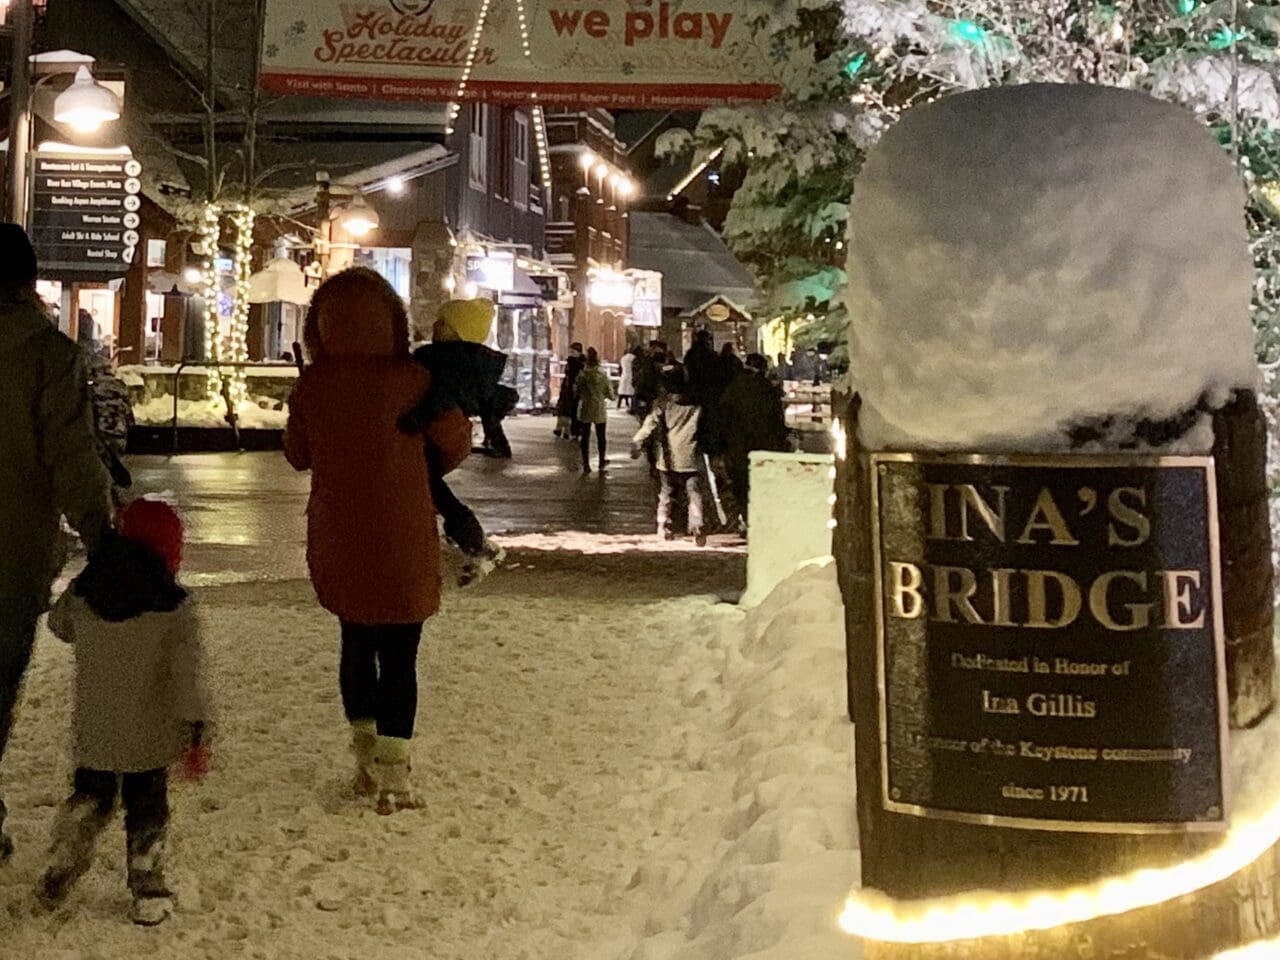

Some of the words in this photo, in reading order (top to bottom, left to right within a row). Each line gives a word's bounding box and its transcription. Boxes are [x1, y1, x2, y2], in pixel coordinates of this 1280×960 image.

[347, 11, 467, 45] Holiday
[549, 10, 610, 38] we
[625, 2, 732, 48] play
[314, 29, 496, 65] Spectacular
[287, 78, 310, 90] Visit
[311, 80, 334, 91] with
[382, 83, 438, 96] Chocolate
[439, 86, 478, 99] Villge
[579, 93, 609, 103] Snow
[612, 93, 636, 104] Fort
[72, 179, 89, 190] Village
[105, 249, 118, 259] Shop
[926, 483, 1152, 548] INA'S
[888, 560, 1207, 631] BRIDGE
[951, 653, 1029, 674] Dedicated
[1033, 657, 1050, 675] in
[1055, 658, 1108, 676] Honor
[1112, 660, 1131, 676] of
[982, 690, 1019, 714] Ina
[1026, 693, 1096, 717] Gillis
[970, 737, 990, 754] of
[991, 738, 1016, 757] the
[1019, 741, 1097, 762] Keystone
[1101, 746, 1193, 764] community
[1002, 784, 1045, 800] since
[1049, 785, 1089, 802] 1971
